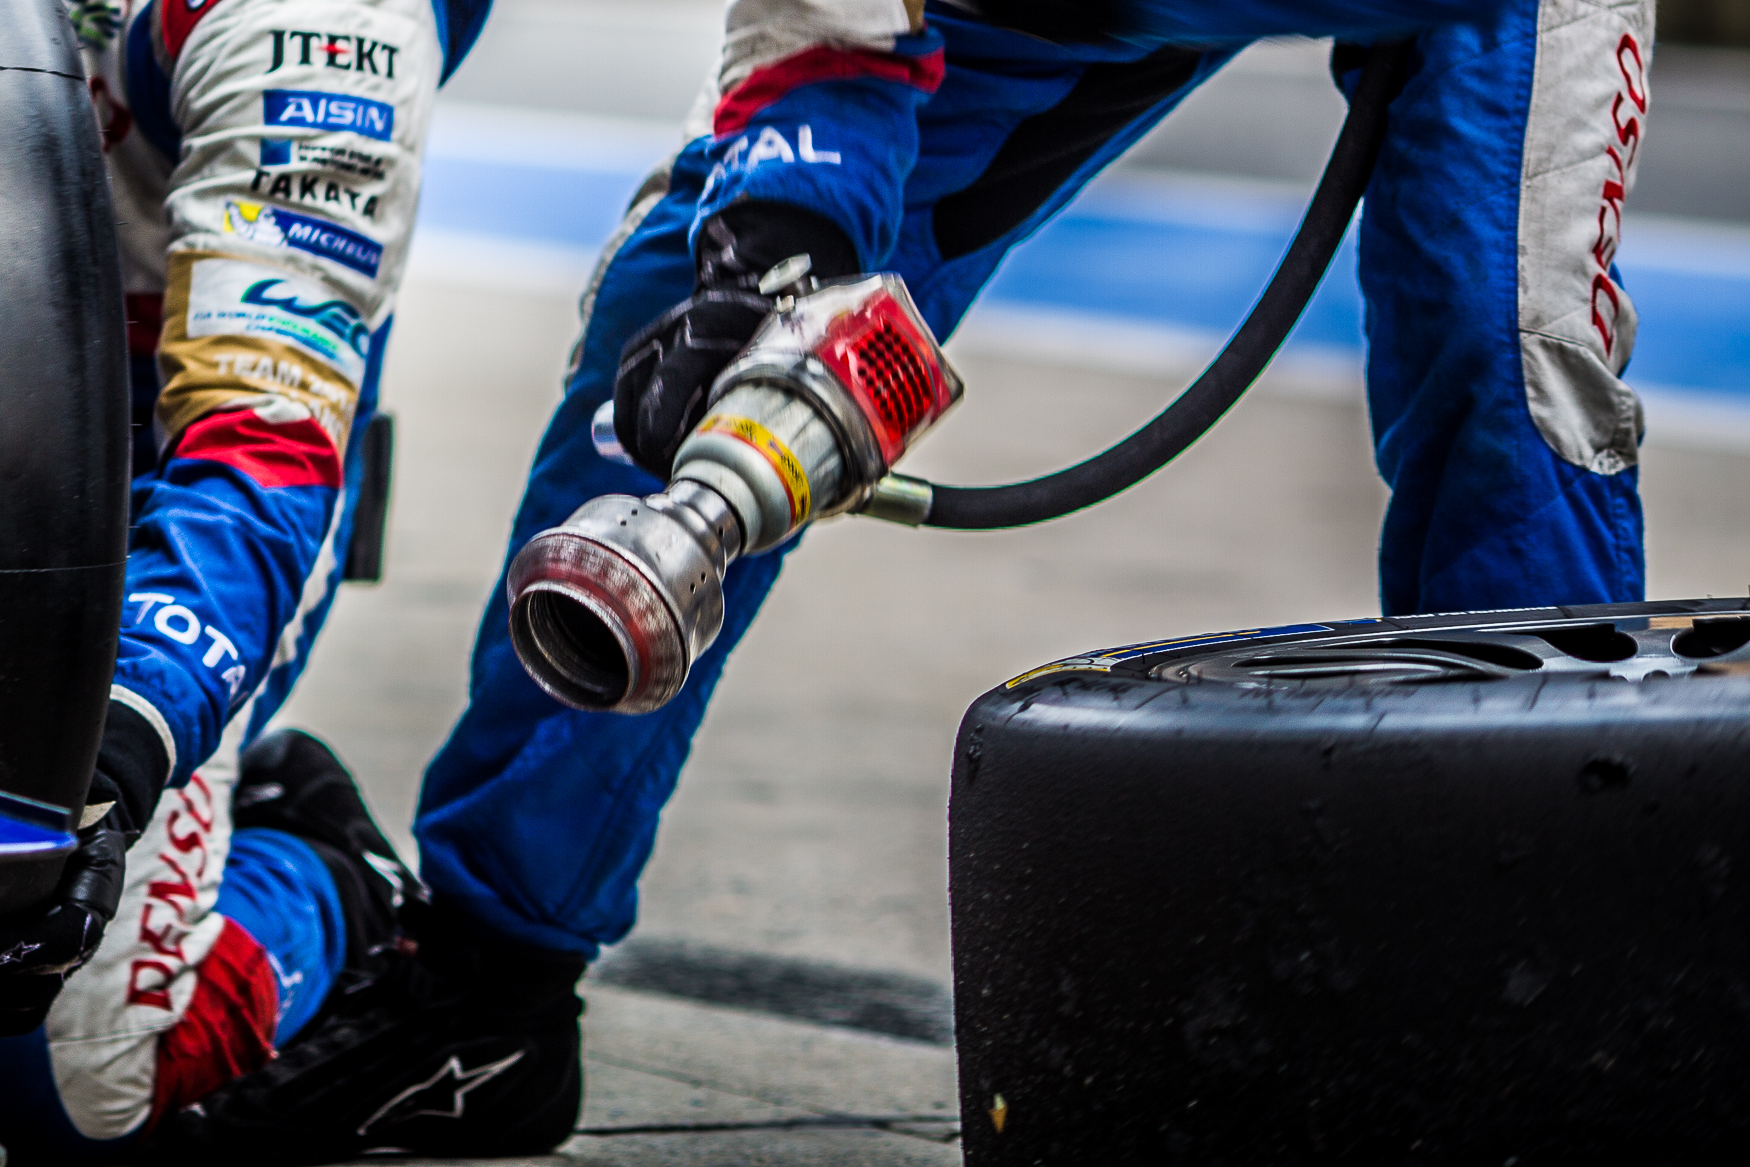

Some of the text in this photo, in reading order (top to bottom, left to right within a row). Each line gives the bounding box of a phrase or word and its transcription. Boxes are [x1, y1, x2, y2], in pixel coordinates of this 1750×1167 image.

[264, 29, 399, 80] JTEKT
[279, 97, 388, 132] AISIN
[250, 168, 380, 219] TAKATA
[1591, 33, 1646, 358] DENSO
[214, 353, 303, 389] TEAM
[128, 592, 249, 706] TOTA
